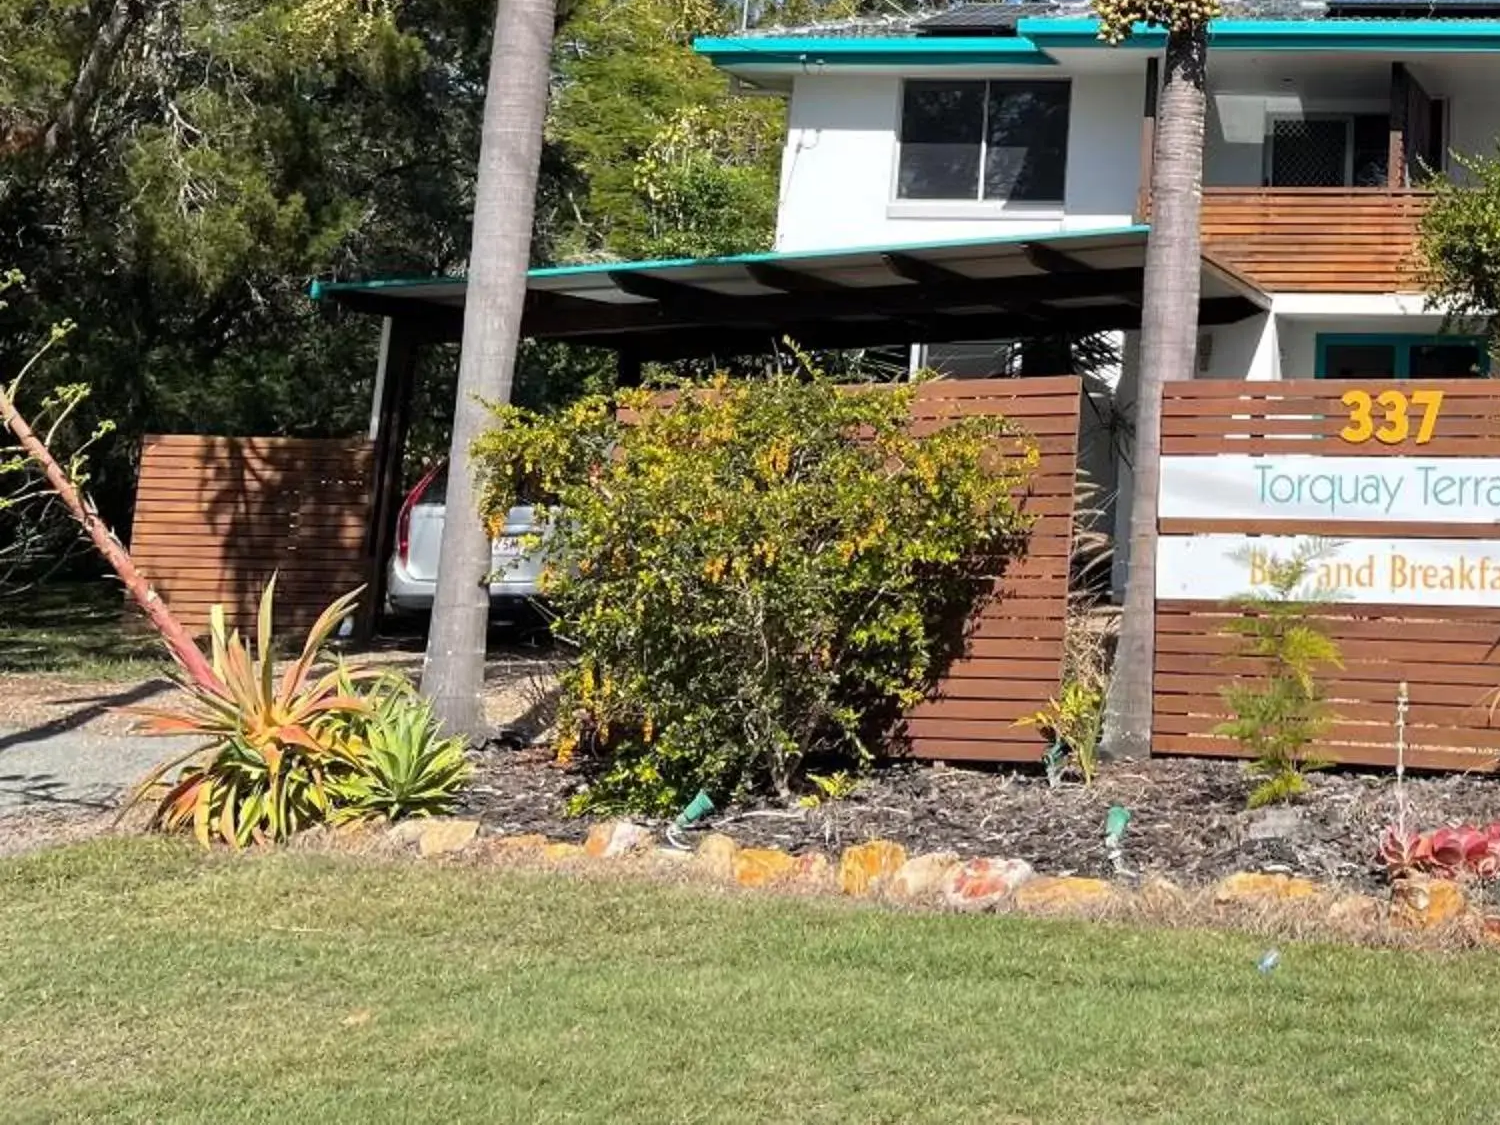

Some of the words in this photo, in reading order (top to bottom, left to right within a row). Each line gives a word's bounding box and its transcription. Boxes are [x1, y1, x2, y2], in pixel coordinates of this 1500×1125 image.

[1341, 390, 1443, 444] 337
[1254, 465, 1403, 513] Torquay
[1317, 554, 1375, 589] and
